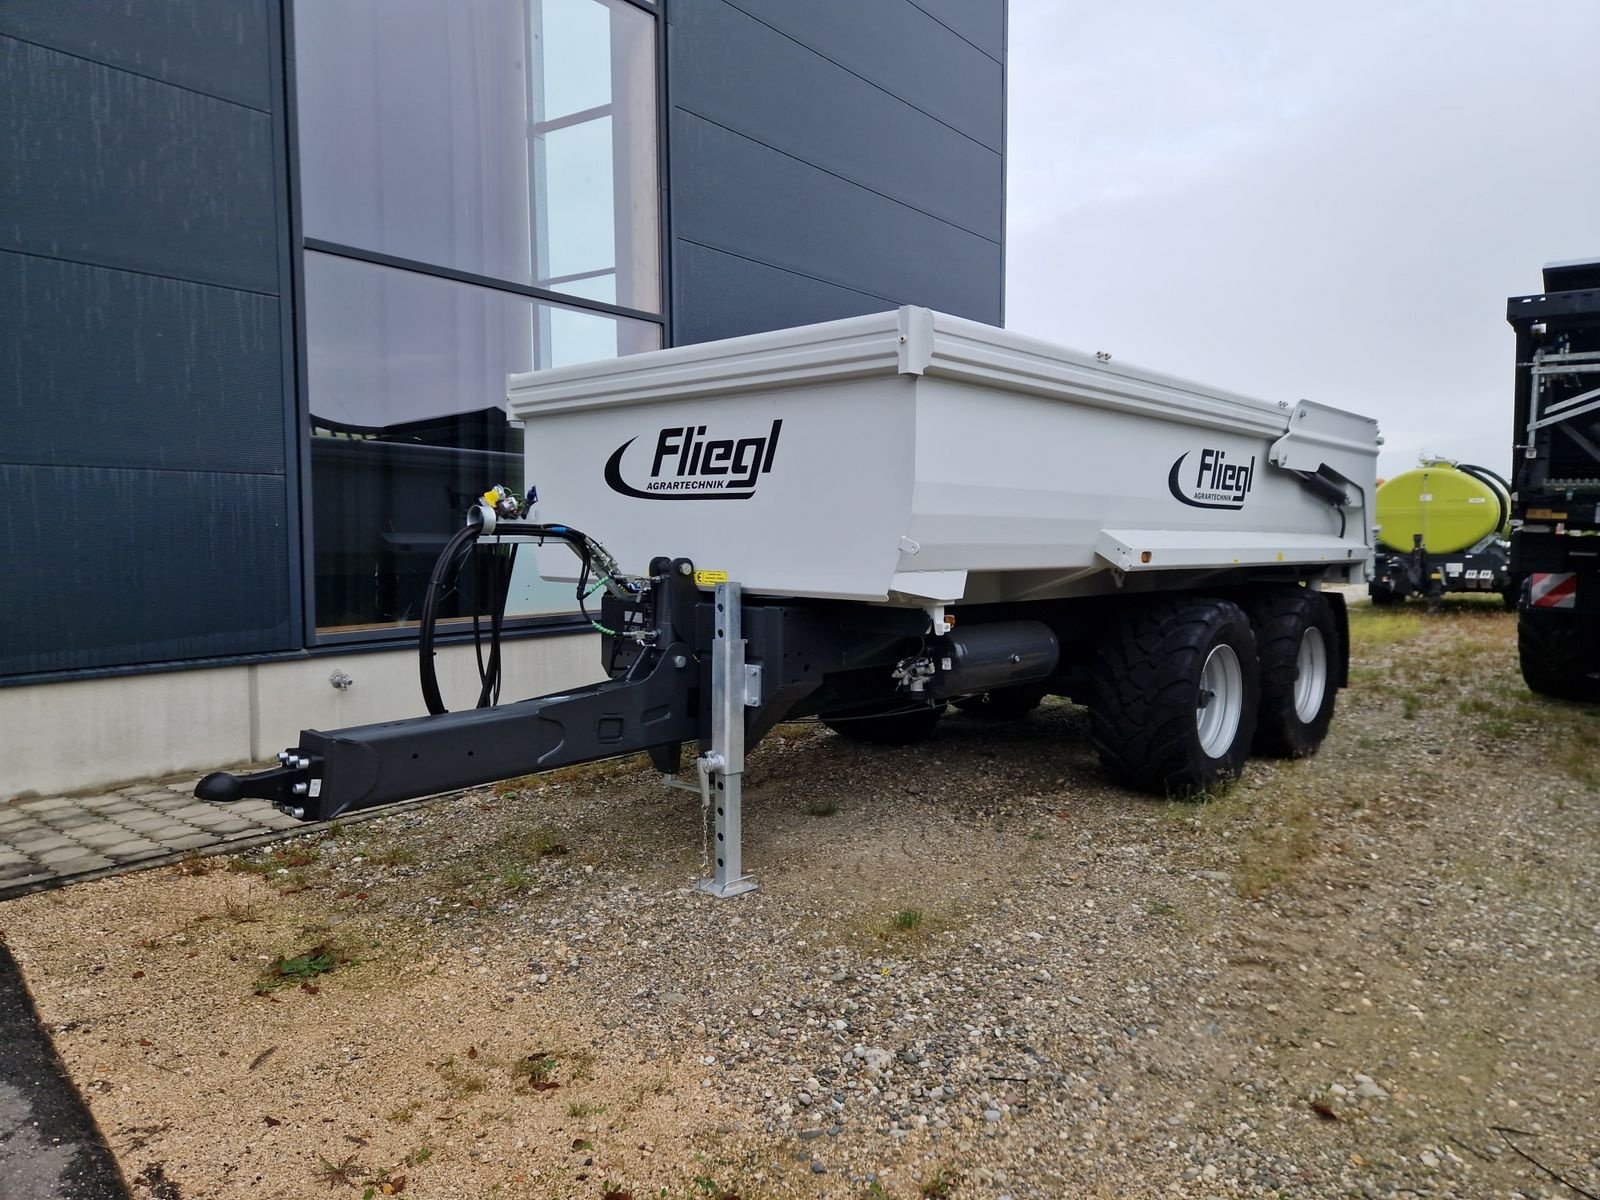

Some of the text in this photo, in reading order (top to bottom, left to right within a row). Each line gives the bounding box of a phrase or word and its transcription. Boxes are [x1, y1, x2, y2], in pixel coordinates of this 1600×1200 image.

[651, 419, 783, 488] Fliegl
[646, 480, 724, 490] AGRARTECHNIK
[1197, 448, 1255, 502] Fliegl
[1194, 493, 1231, 501] AGRARTECHNIK
